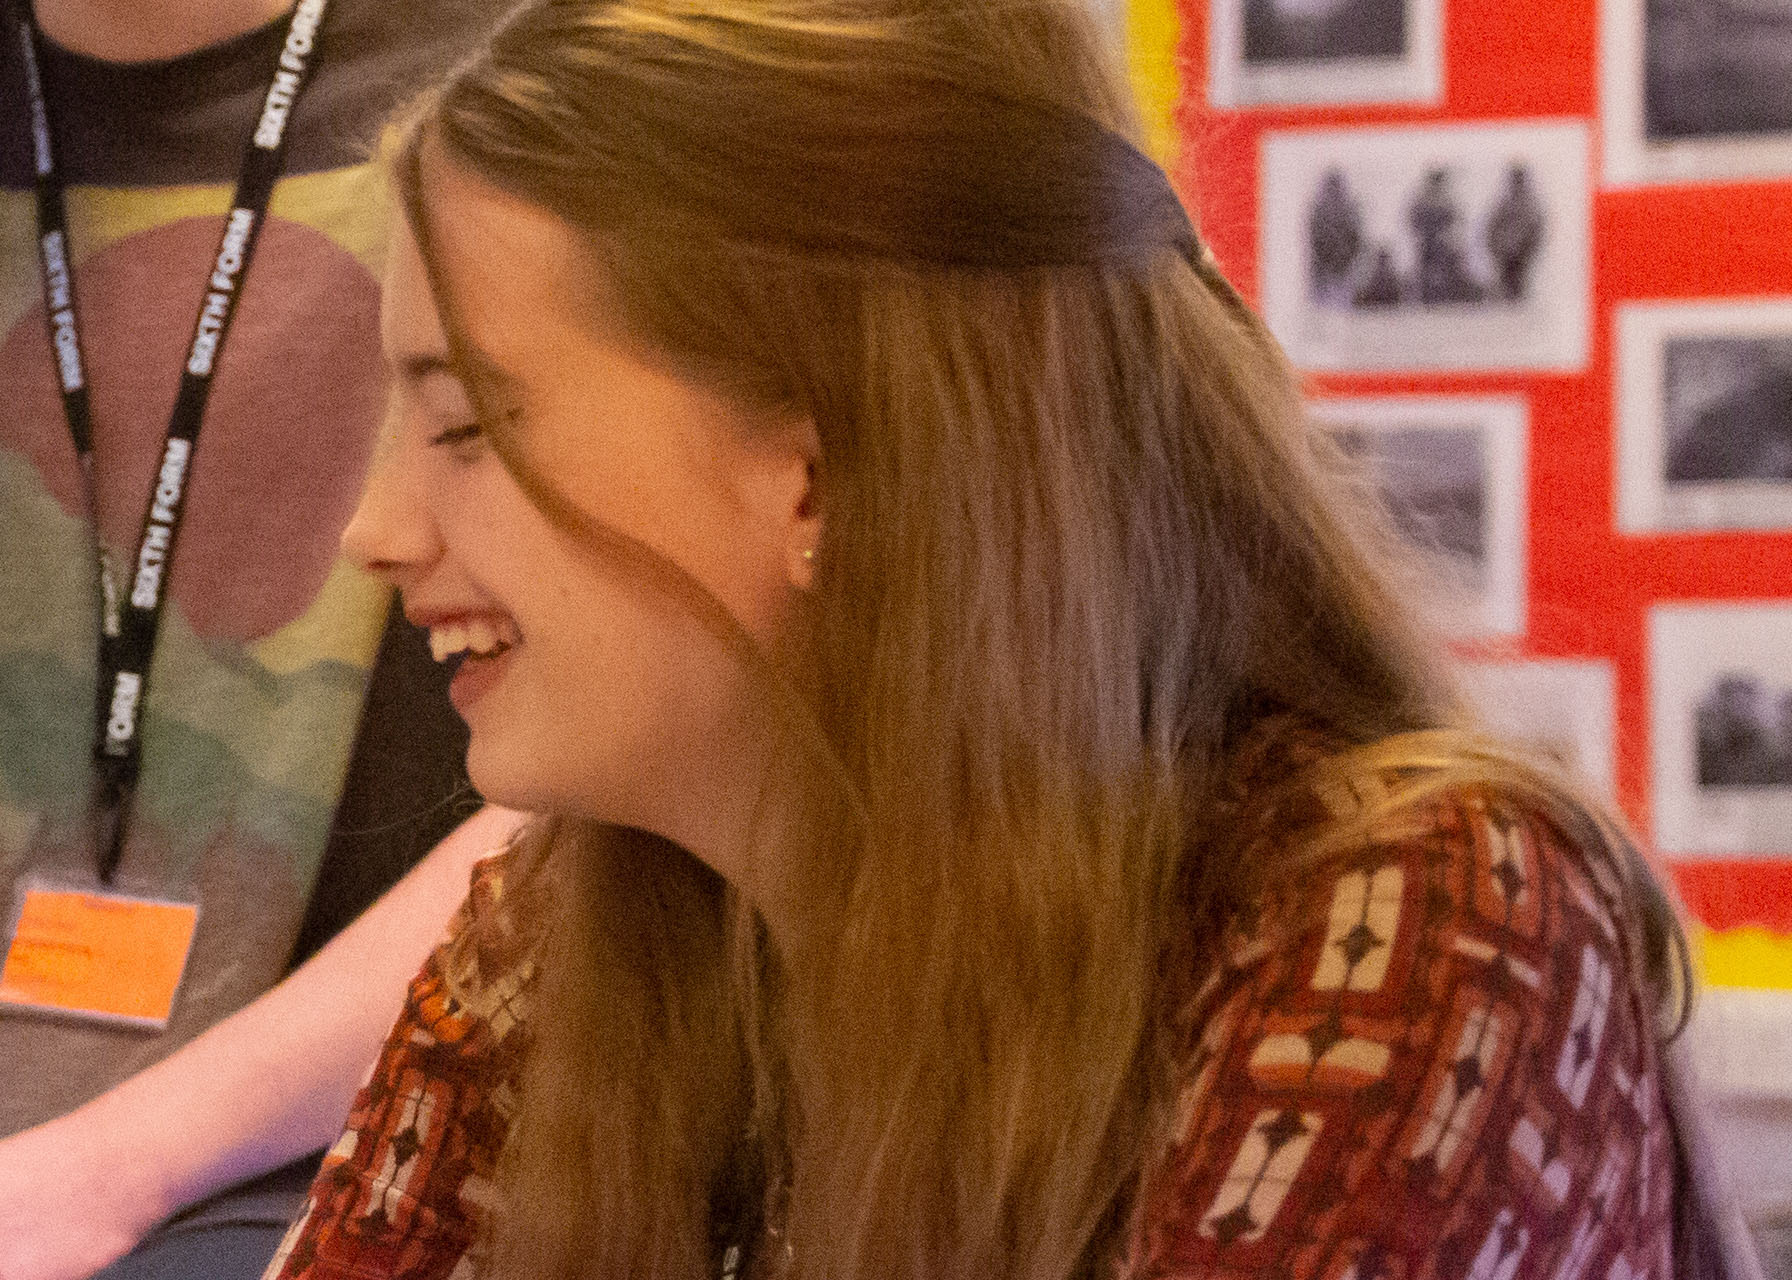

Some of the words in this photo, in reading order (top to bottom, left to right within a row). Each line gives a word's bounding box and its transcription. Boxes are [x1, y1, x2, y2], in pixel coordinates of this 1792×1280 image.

[188, 293, 230, 378] SIXTH
[212, 207, 255, 292] FORM
[131, 525, 170, 608] SIXTH
[151, 438, 192, 521] FORM
